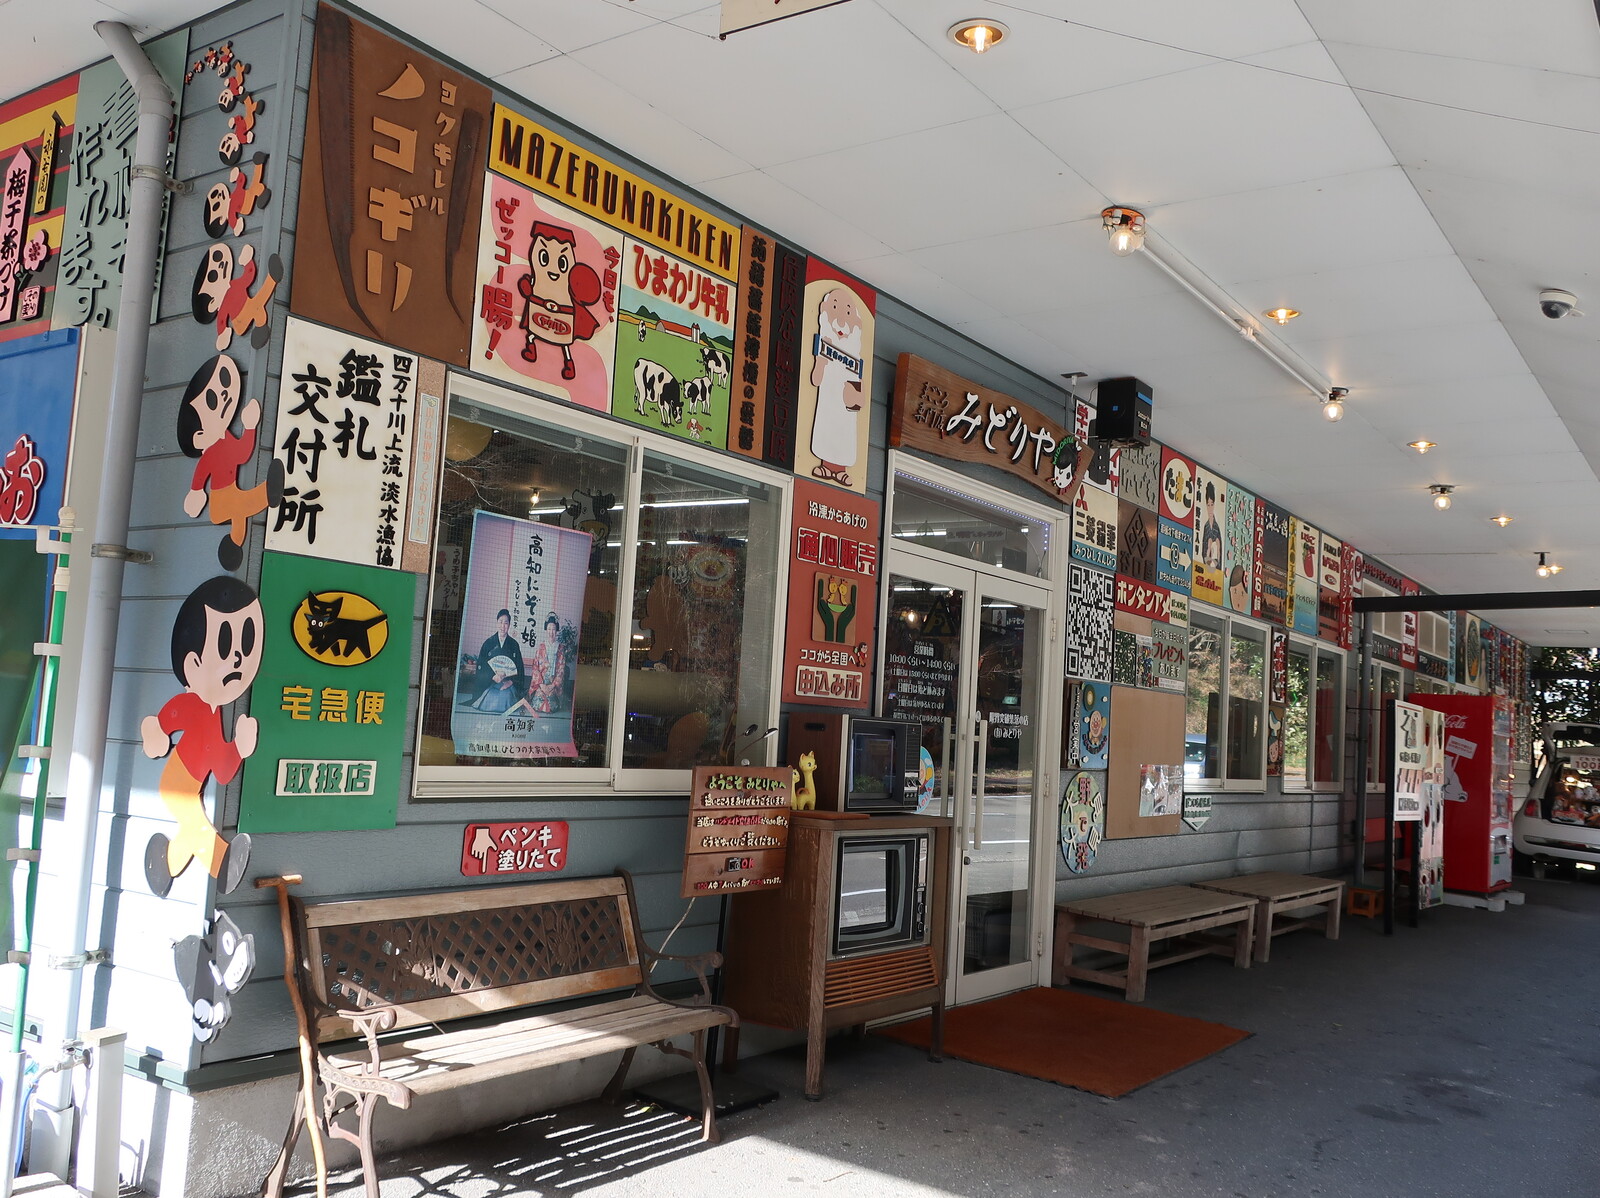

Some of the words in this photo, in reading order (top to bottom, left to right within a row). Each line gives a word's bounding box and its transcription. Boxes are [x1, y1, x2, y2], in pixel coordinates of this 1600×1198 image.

[429, 80, 457, 216] ヨクキレル
[367, 63, 427, 312] ノコギリ
[499, 117, 734, 272] MAZERUNAKIKEN
[633, 245, 730, 325] ひまわり牛乳
[332, 348, 384, 461] 鑑札
[273, 363, 332, 545] 交付所
[946, 392, 1056, 476] みどりや
[376, 353, 413, 567] 四万十川上流淡水漁協
[1163, 466, 1193, 509] たまご
[808, 500, 868, 530] 冷凍からあげの
[1076, 511, 1116, 552] 三菱鉛筆
[798, 527, 876, 576] 通信販売
[1075, 543, 1117, 569] みつびしえんぴつ
[521, 533, 544, 648] 高知にぞっ婚
[800, 648, 856, 666] ココから全国へ
[1153, 641, 1185, 666] プレゼント
[798, 668, 862, 699] 申込み所
[281, 685, 385, 725] 宅急便
[504, 717, 536, 732] 高知家
[284, 763, 373, 794] 取扱店
[709, 773, 743, 791] ようこそ
[746, 776, 787, 791] みどりやへ
[500, 826, 552, 846] ペンキ
[498, 847, 562, 872] 塗りたて
[741, 858, 756, 869] OK
